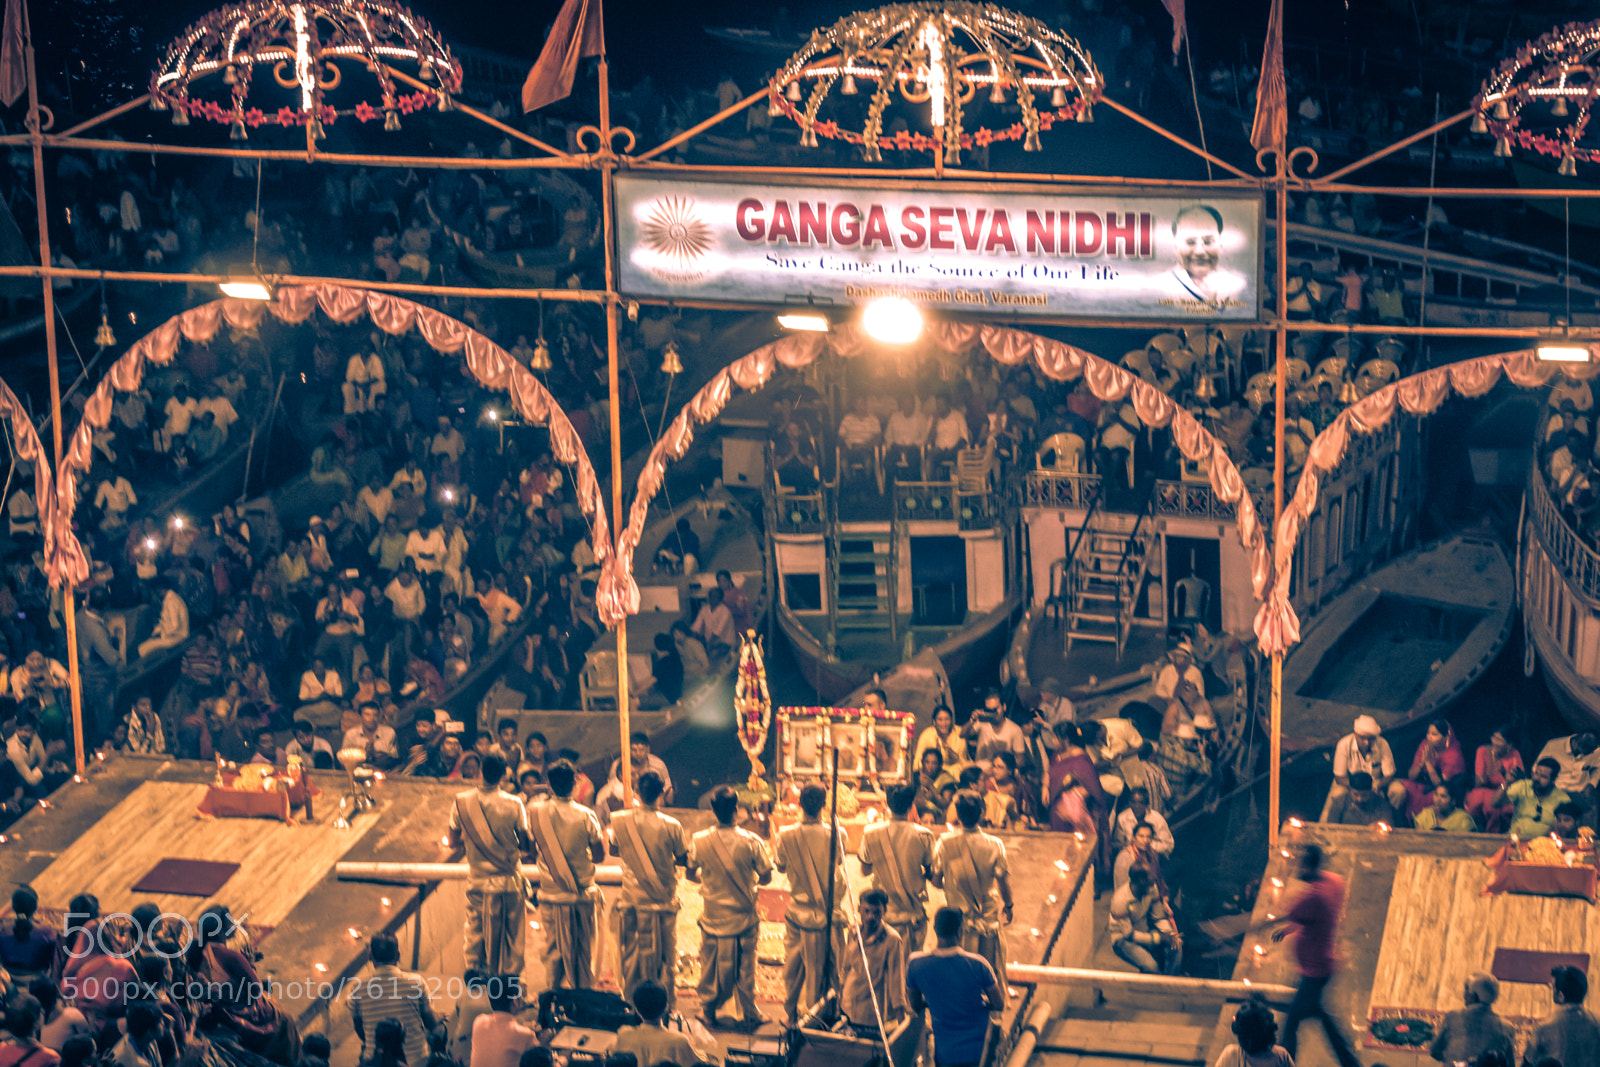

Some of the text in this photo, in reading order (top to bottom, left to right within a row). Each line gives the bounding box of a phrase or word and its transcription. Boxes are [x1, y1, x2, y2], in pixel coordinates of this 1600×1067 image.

[735, 198, 1151, 256] GANGA SEVA NIDHI
[766, 252, 1119, 280] Save Ganga the Source of Our Life
[954, 289, 989, 307] Ghat,
[990, 289, 1048, 306] Varanasi
